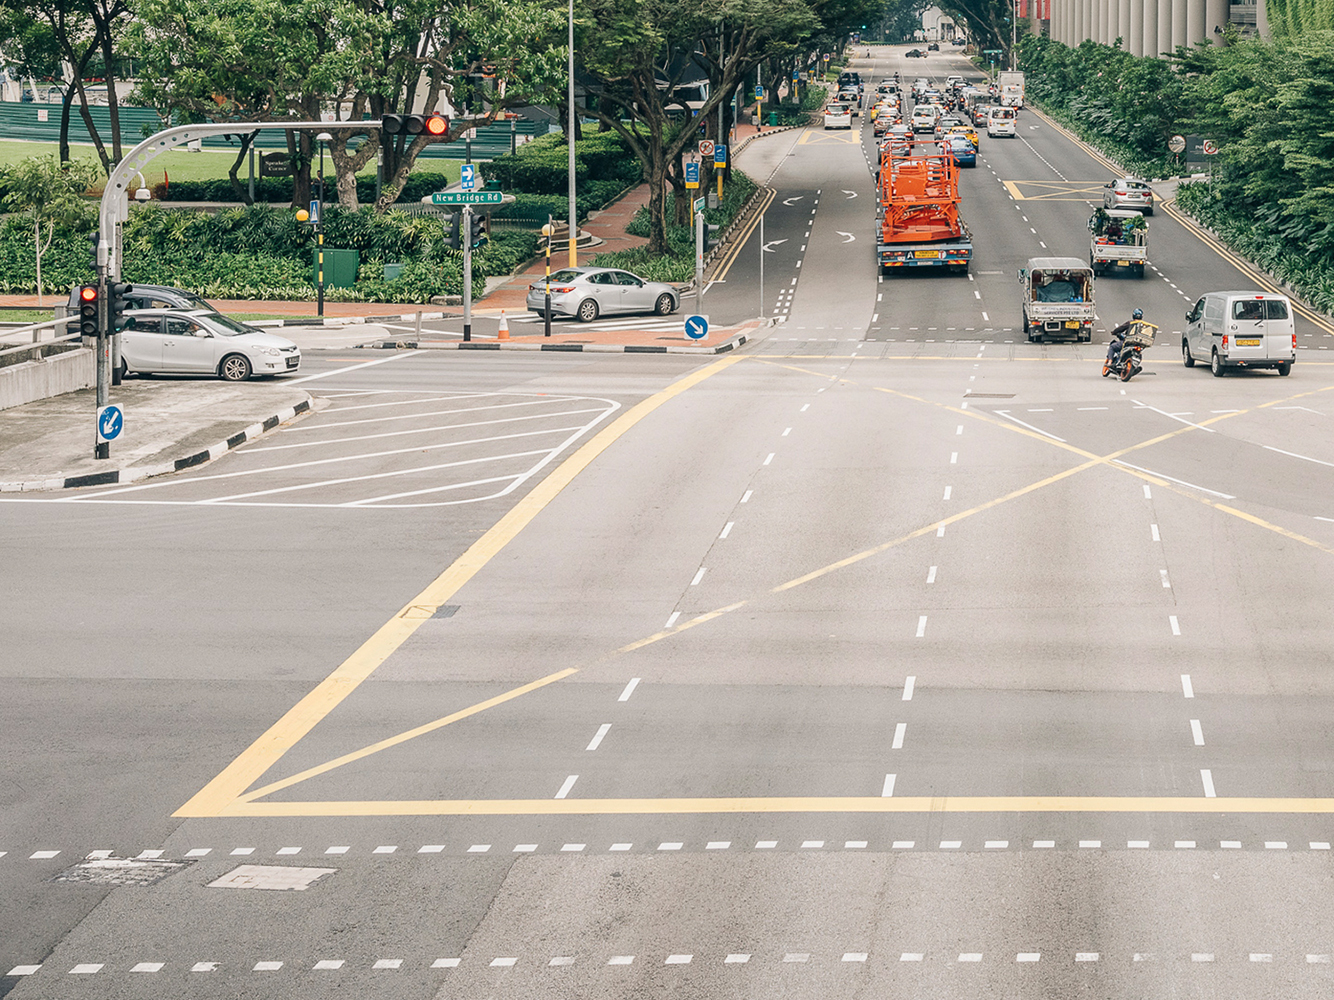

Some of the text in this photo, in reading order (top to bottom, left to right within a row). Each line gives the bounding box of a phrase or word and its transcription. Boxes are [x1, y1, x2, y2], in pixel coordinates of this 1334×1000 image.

[436, 193, 498, 203] New Bridge Rd
